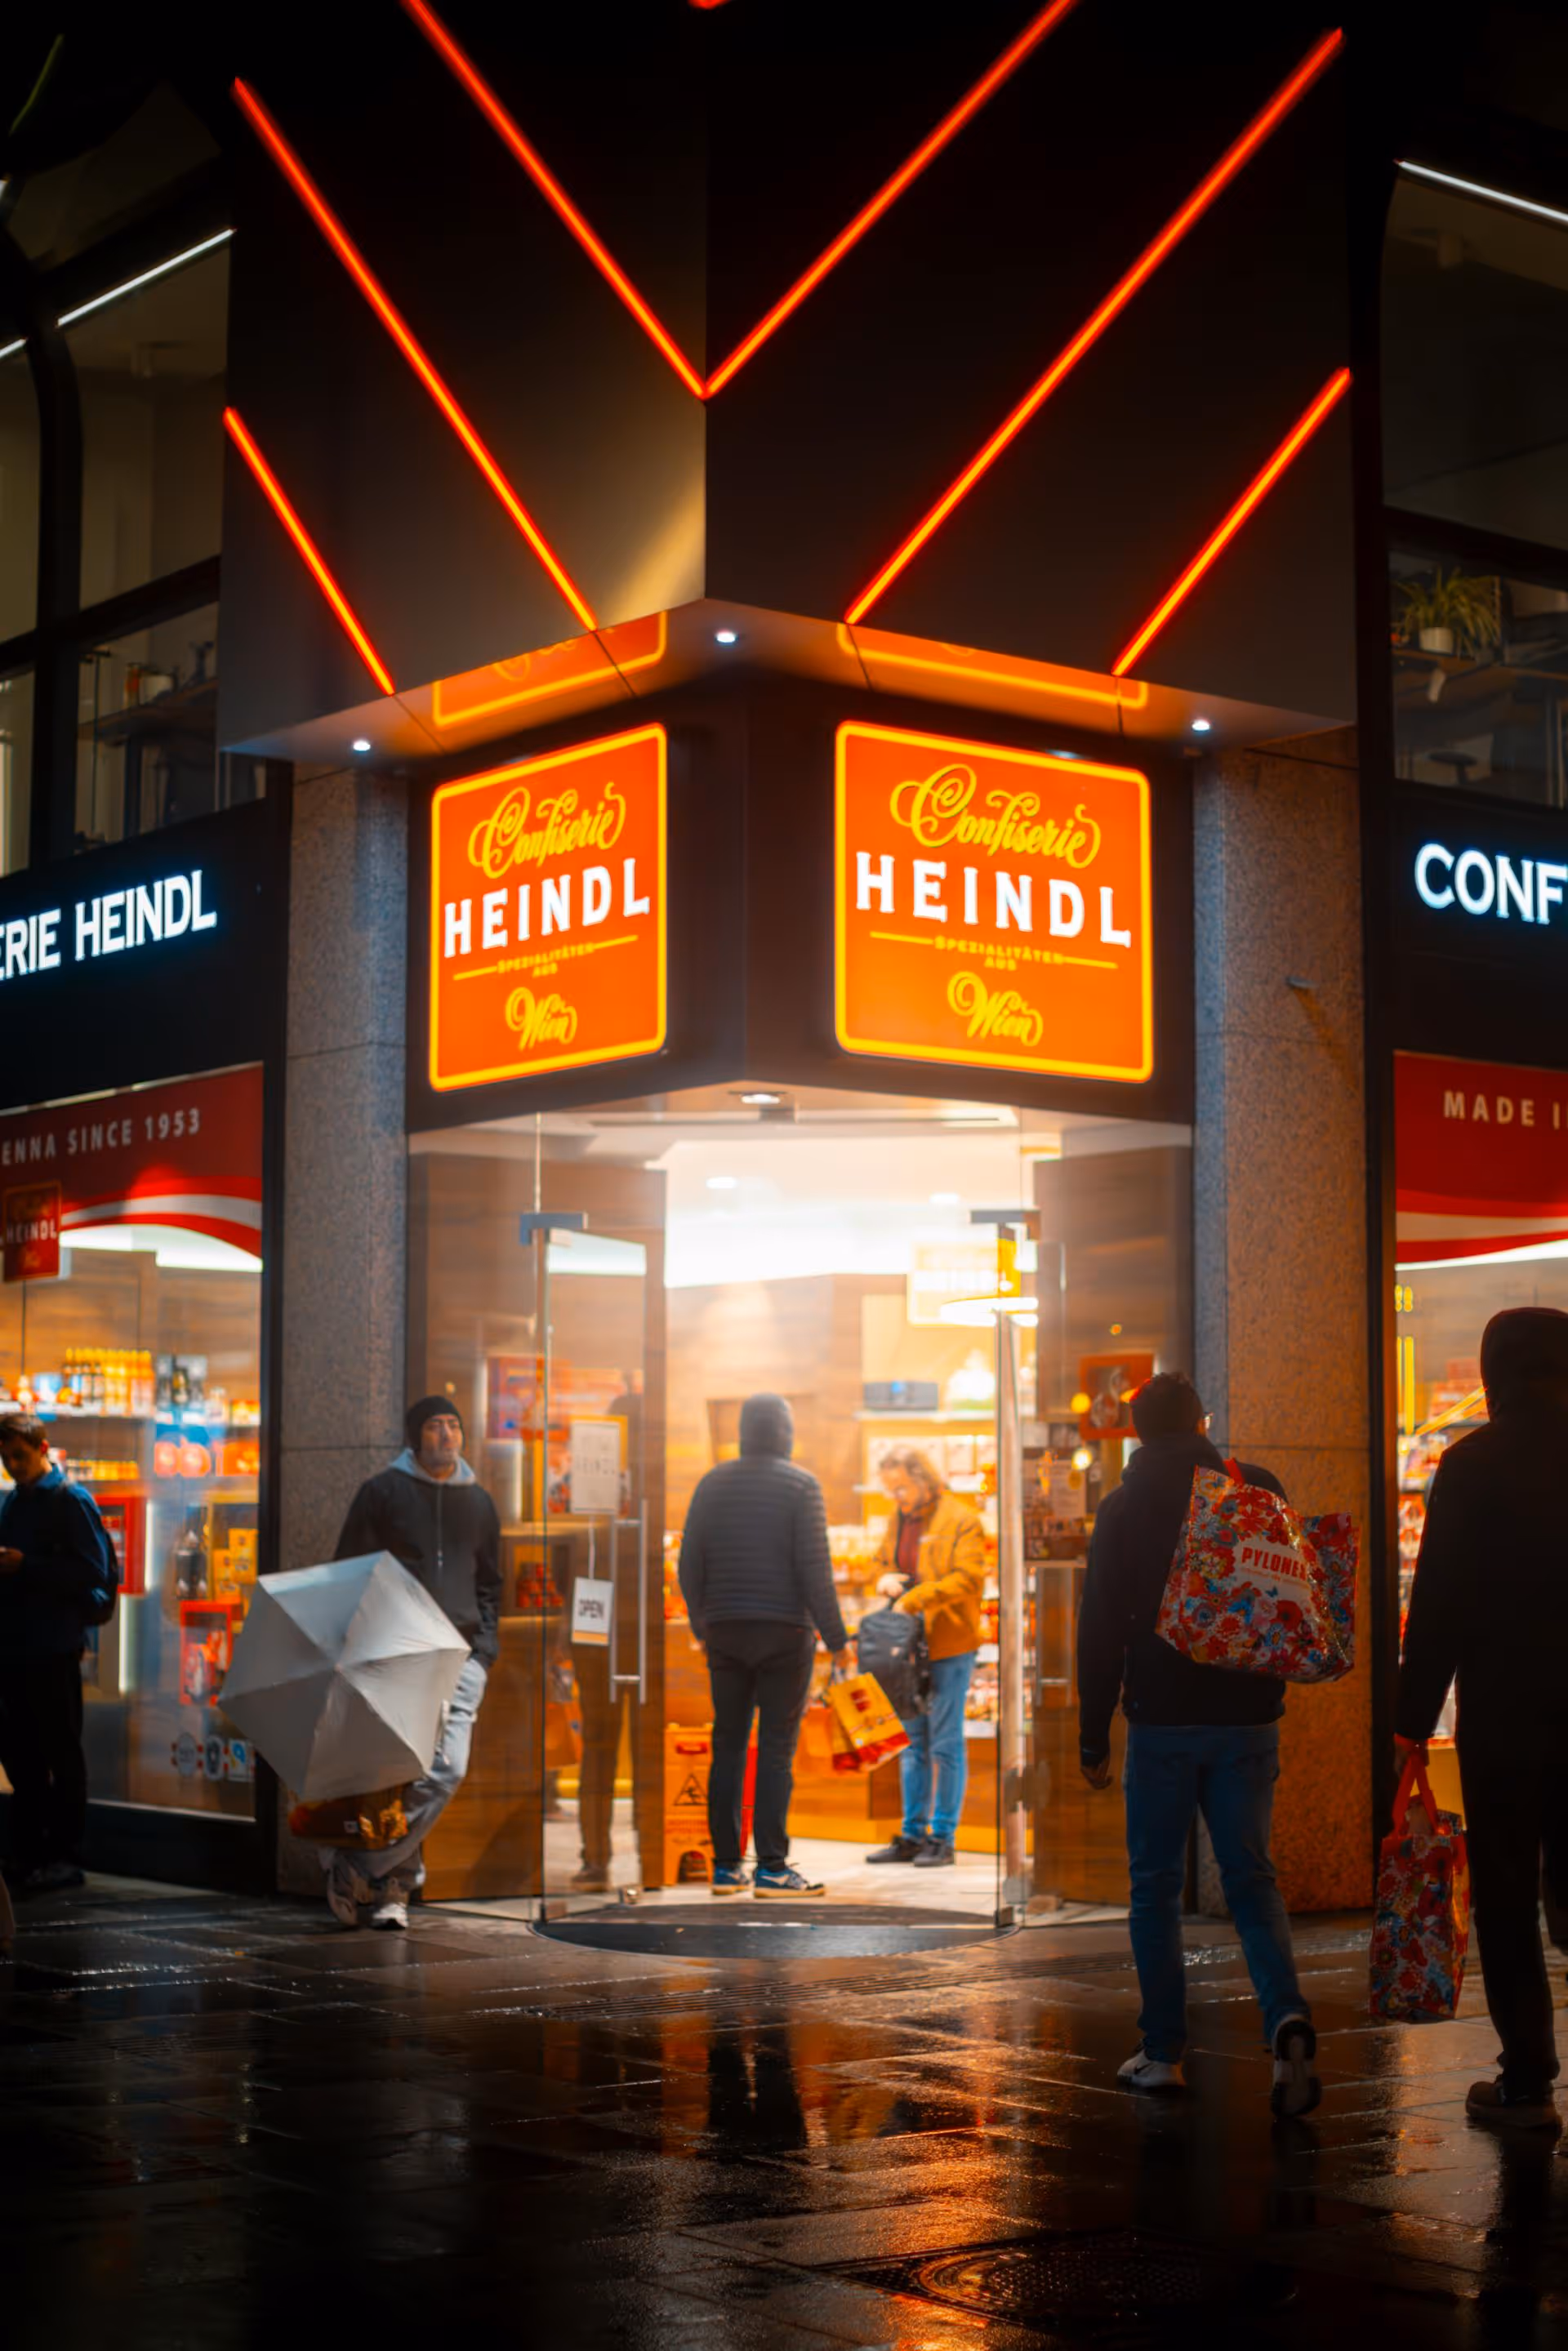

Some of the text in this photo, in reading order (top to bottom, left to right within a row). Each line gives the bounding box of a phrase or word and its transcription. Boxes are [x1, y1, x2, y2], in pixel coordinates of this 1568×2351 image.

[468, 781, 626, 879] Confiserie
[889, 764, 1101, 869] Confiserie
[0, 870, 217, 980] RIE HEINDL
[444, 857, 650, 958] HEINDL
[856, 851, 1132, 948] HEINDL
[1414, 844, 1568, 924] CONF
[504, 986, 578, 1051] Wien
[947, 971, 1044, 1048] Wien
[67, 1119, 132, 1155] SINCE
[144, 1107, 200, 1140] 1953
[1443, 1090, 1535, 1128] MADE
